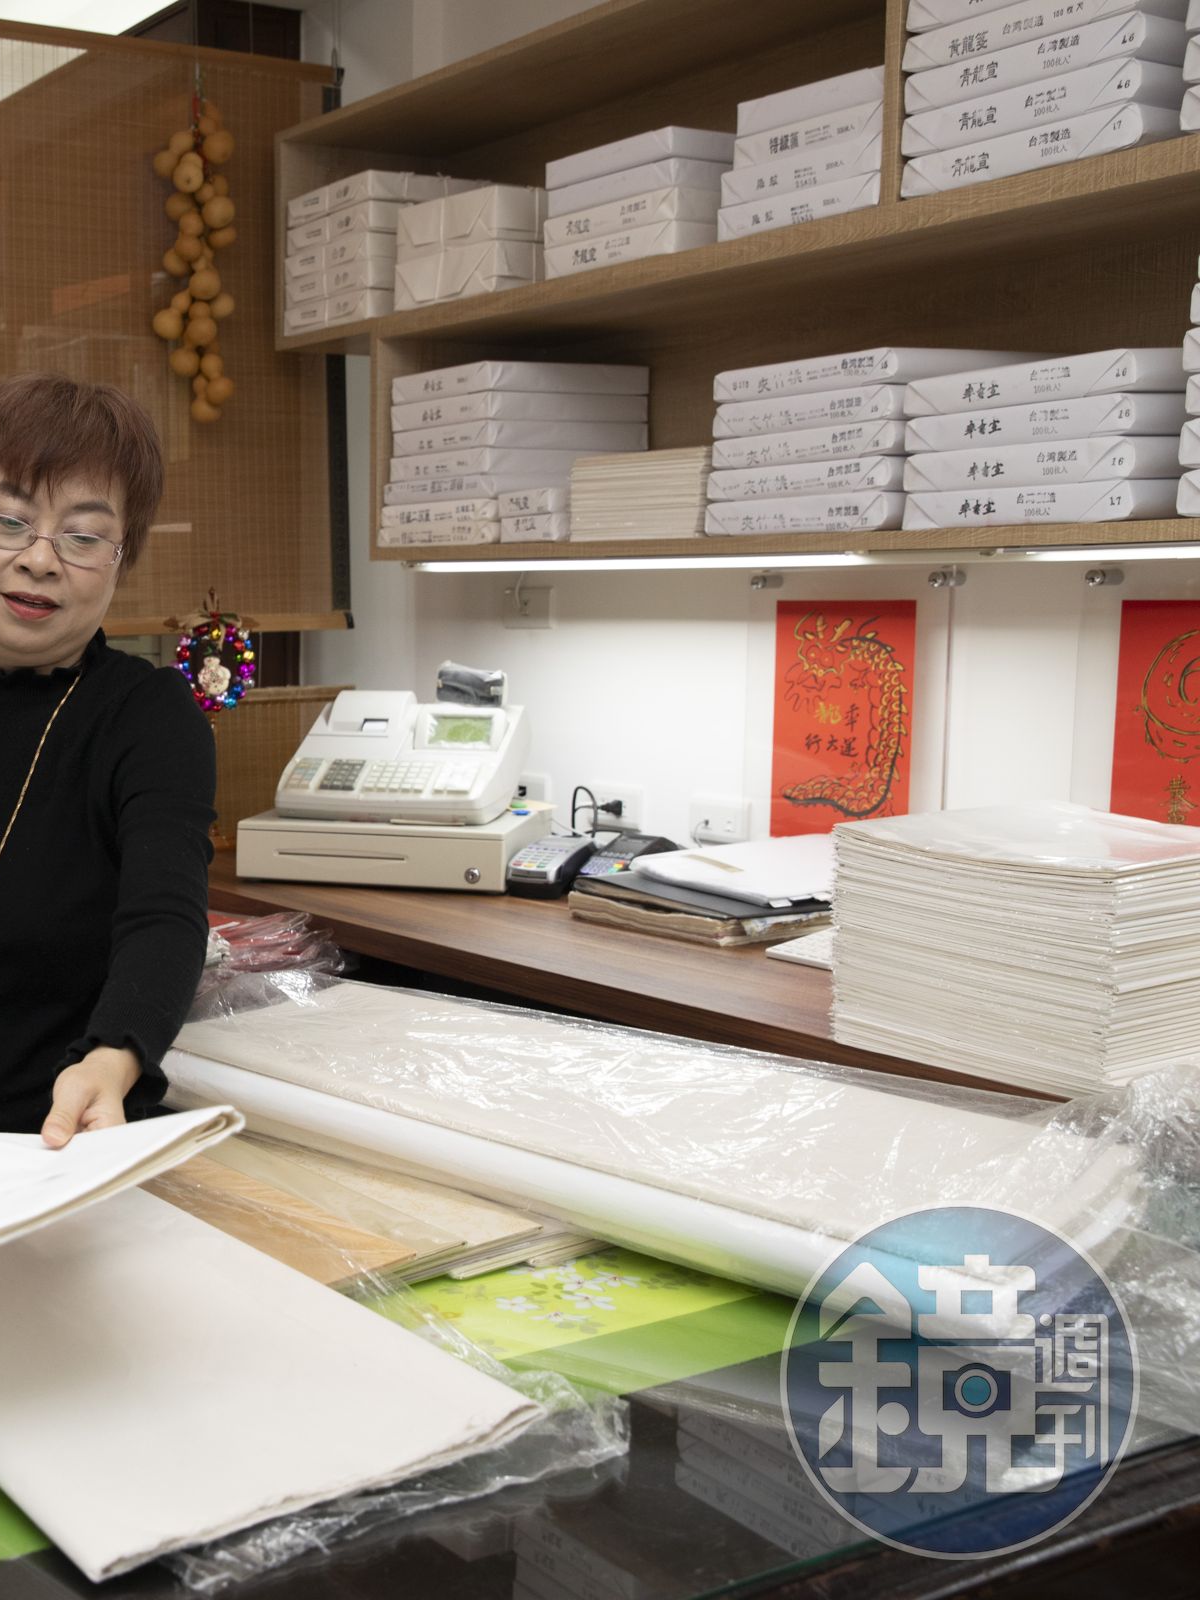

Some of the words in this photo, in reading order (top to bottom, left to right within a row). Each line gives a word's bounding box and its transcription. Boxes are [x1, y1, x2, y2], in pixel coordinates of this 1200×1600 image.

[959, 61, 999, 87] 青龍宣
[804, 732, 859, 757] 行大運
